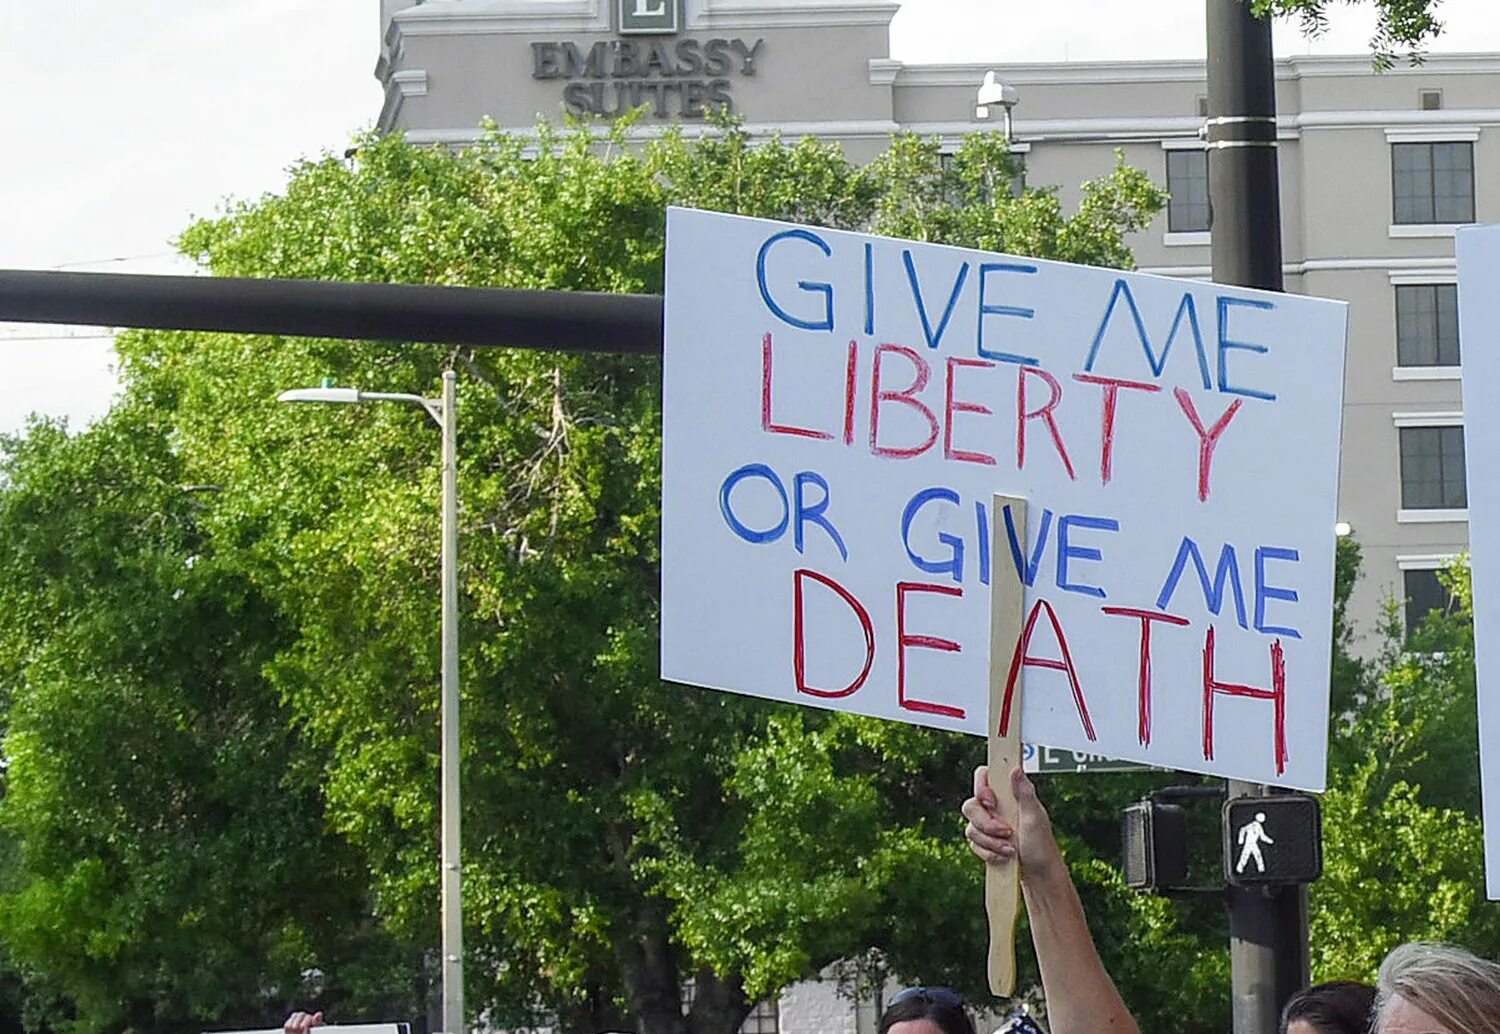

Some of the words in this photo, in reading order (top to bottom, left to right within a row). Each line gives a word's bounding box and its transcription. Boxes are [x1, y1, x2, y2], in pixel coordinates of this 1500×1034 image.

[530, 38, 764, 79] EMBASSY
[563, 79, 733, 119] SUITES
[757, 229, 1040, 367] GIVE
[1085, 279, 1277, 400] ME
[762, 333, 1243, 502] LIBERTY
[719, 463, 848, 562] OR
[901, 487, 1120, 598] GIVE
[1156, 536, 1301, 638] ME
[794, 569, 1288, 776] DEATH
